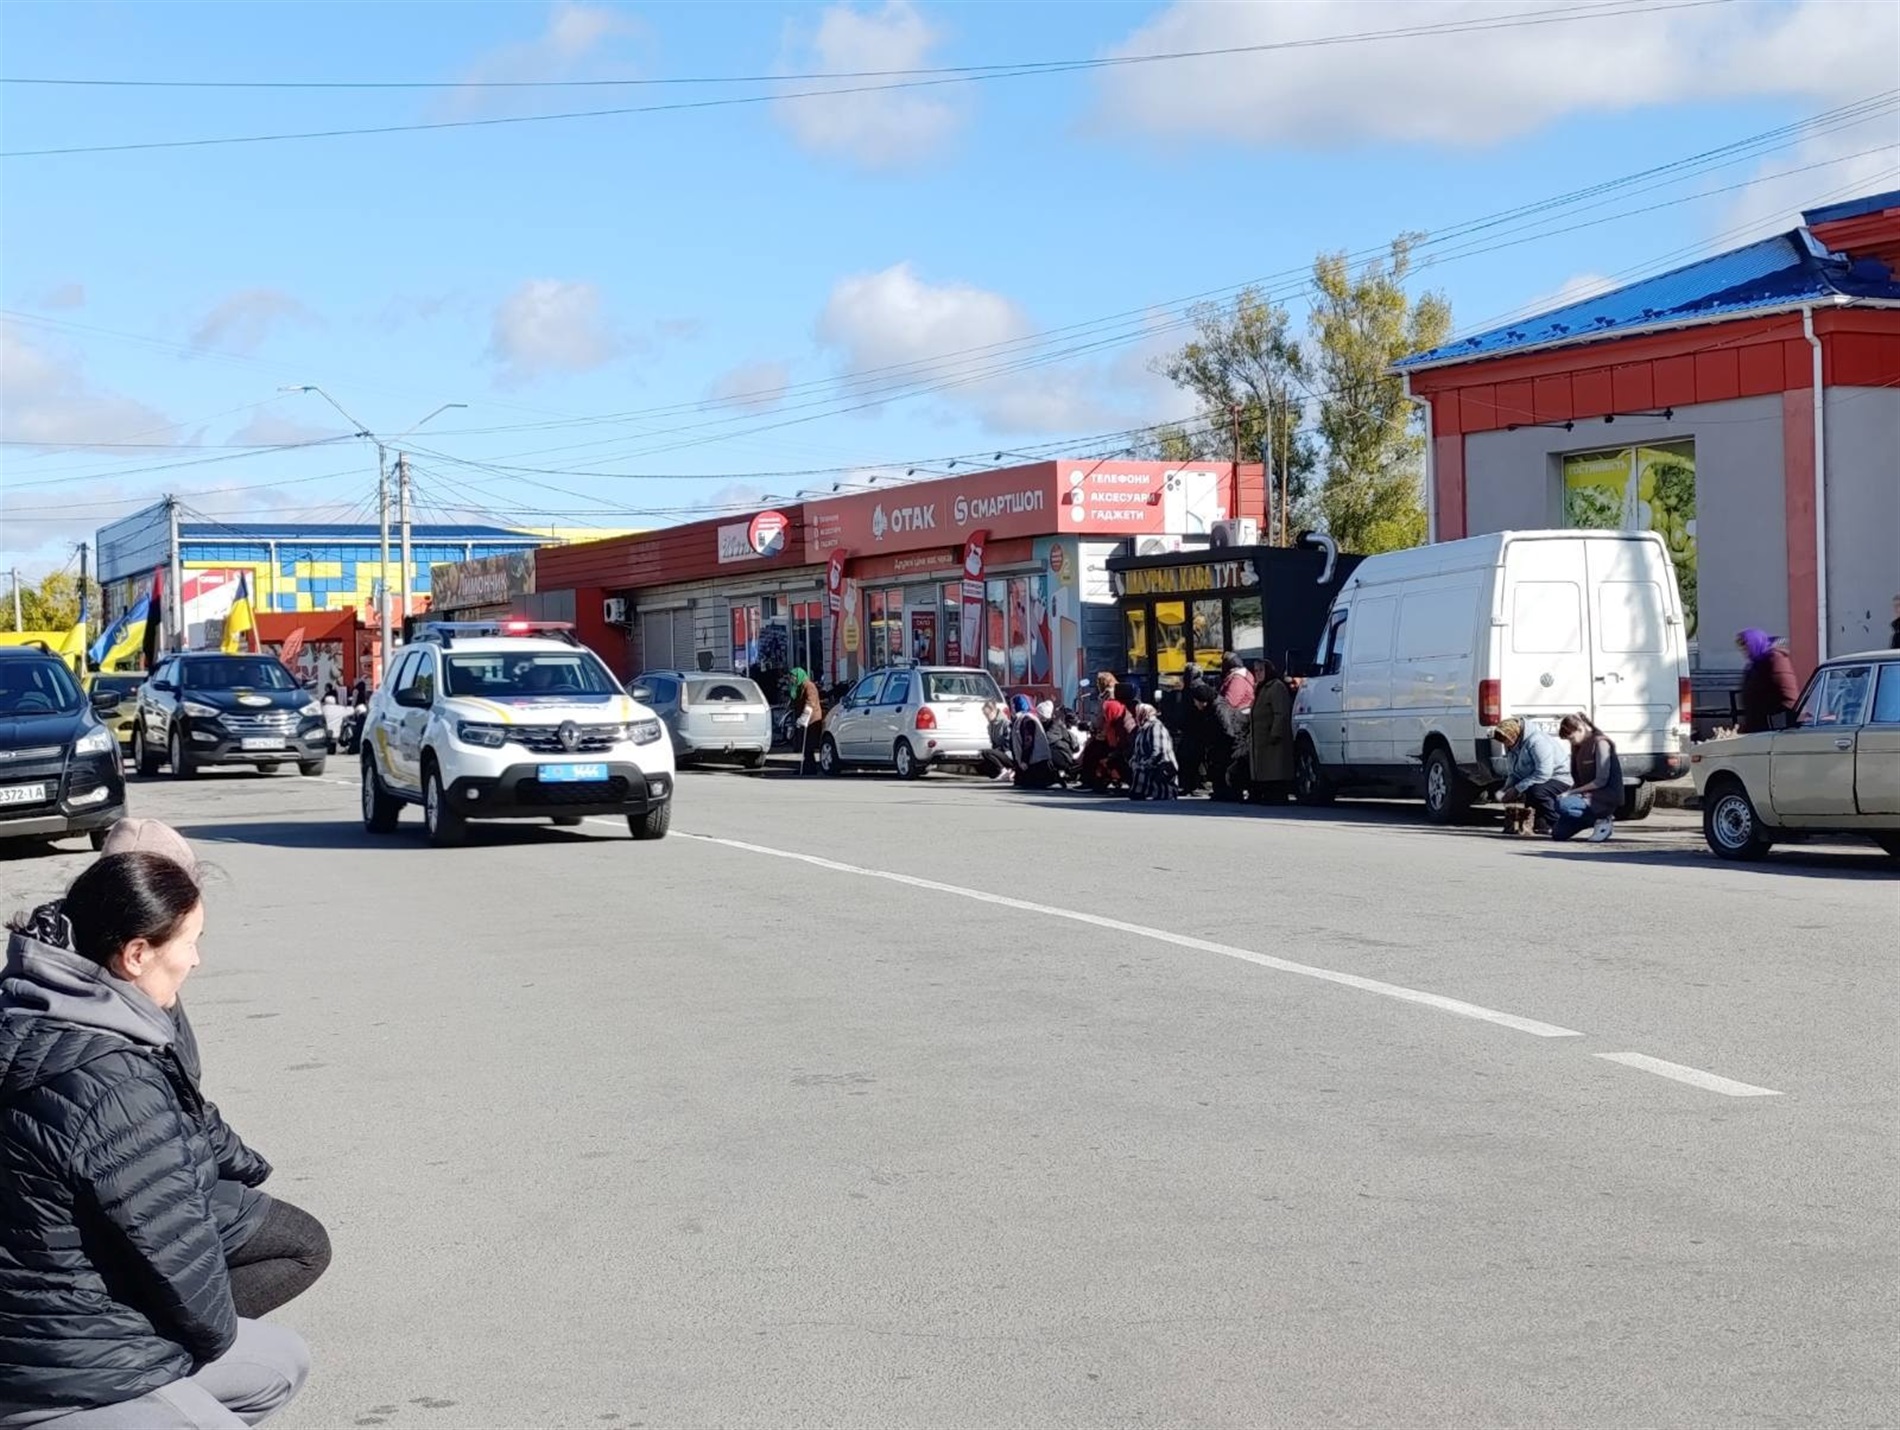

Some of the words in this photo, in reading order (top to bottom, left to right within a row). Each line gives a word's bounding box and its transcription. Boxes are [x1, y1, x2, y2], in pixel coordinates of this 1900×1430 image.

[1090, 473, 1150, 484] ТЕЛЕФОНИ
[970, 490, 1044, 519] СМАРТШОП
[1090, 509, 1145, 521] ГАДЖЕТИ
[891, 504, 936, 533] ОТАК
[1214, 562, 1238, 588] ТУТ
